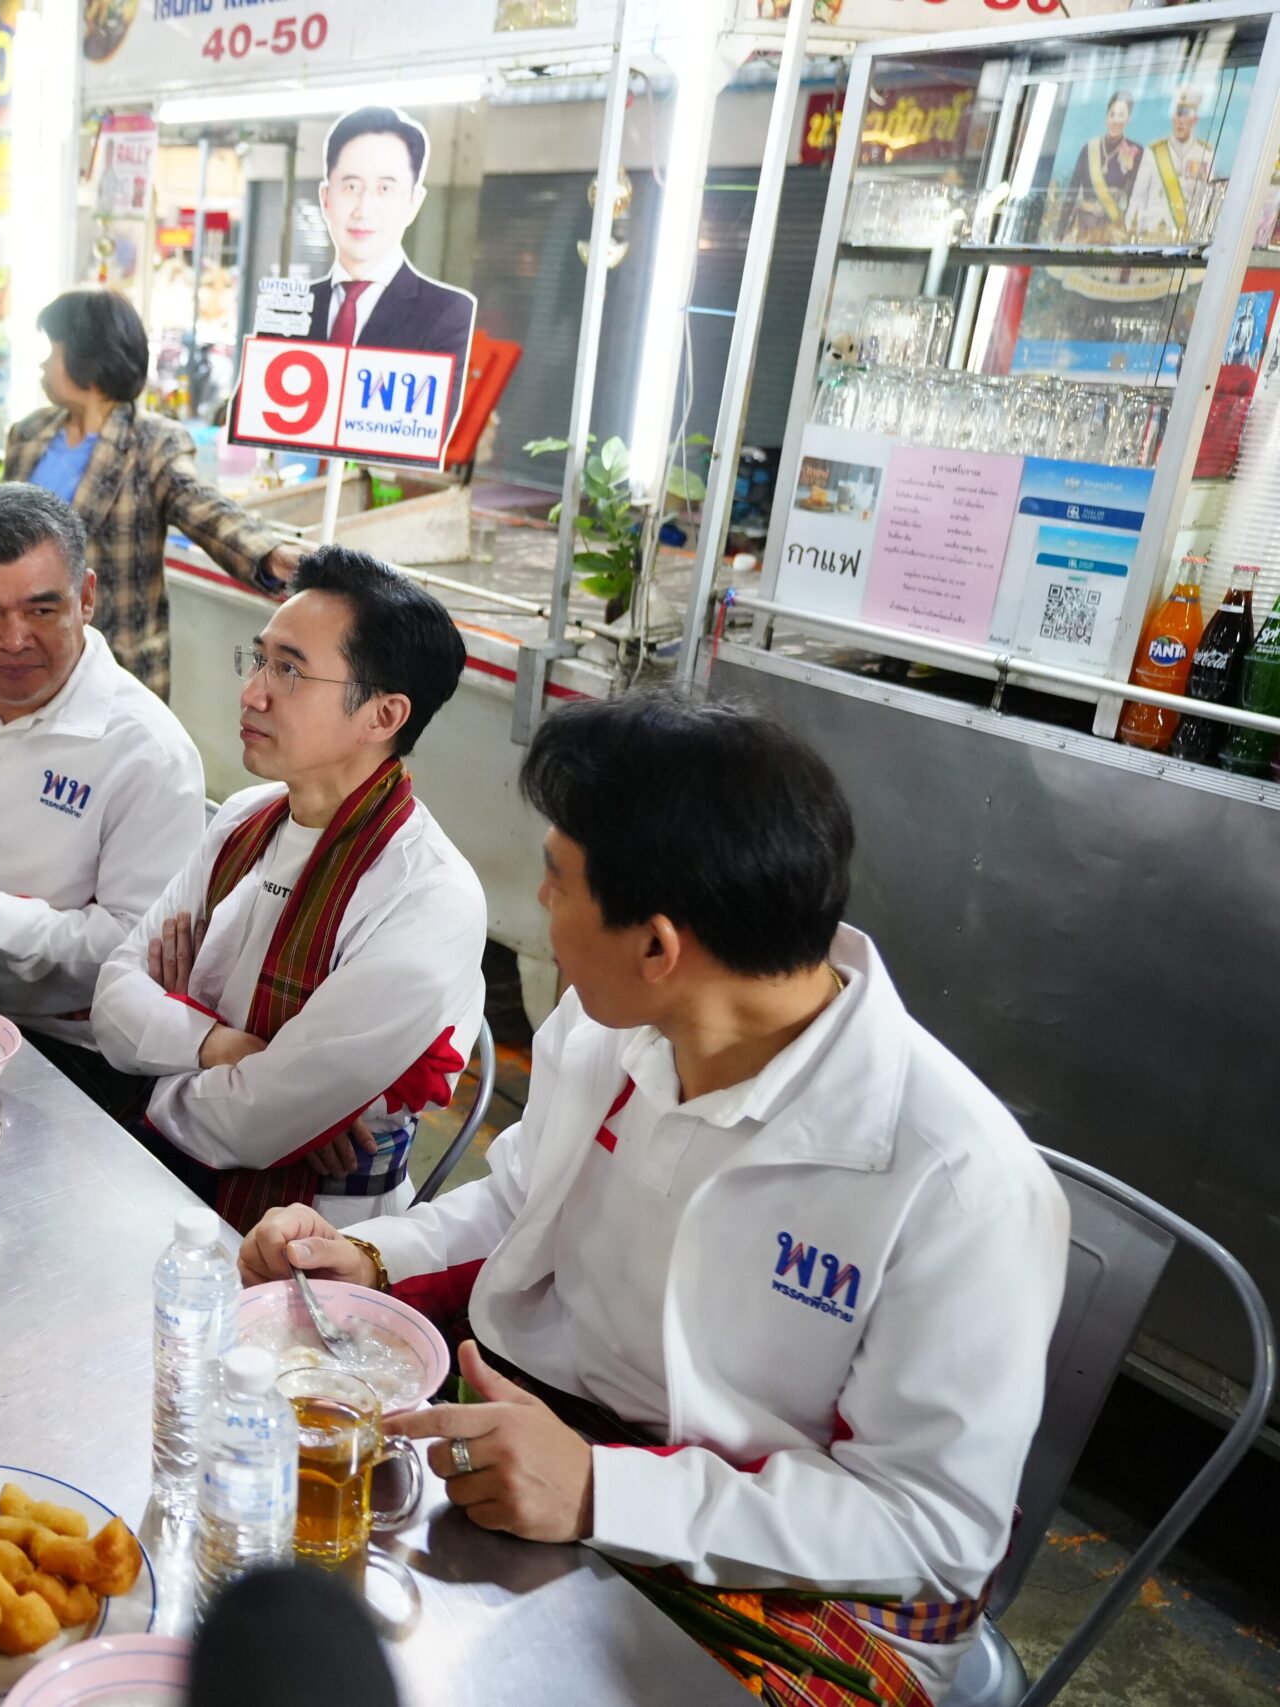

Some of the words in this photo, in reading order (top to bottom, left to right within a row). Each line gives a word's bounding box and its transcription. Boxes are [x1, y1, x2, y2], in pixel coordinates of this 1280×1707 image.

[201, 12, 329, 62] 40-50
[261, 350, 329, 436] 9
[357, 368, 438, 416] พท
[344, 416, 438, 440] พรรคเพื่อไทย
[788, 543, 862, 578] กาแฟ
[1148, 640, 1186, 659] FANTA
[42, 769, 91, 810] พท
[775, 1231, 861, 1309] พท
[771, 1279, 854, 1323] พรรคเพื่อไทย
